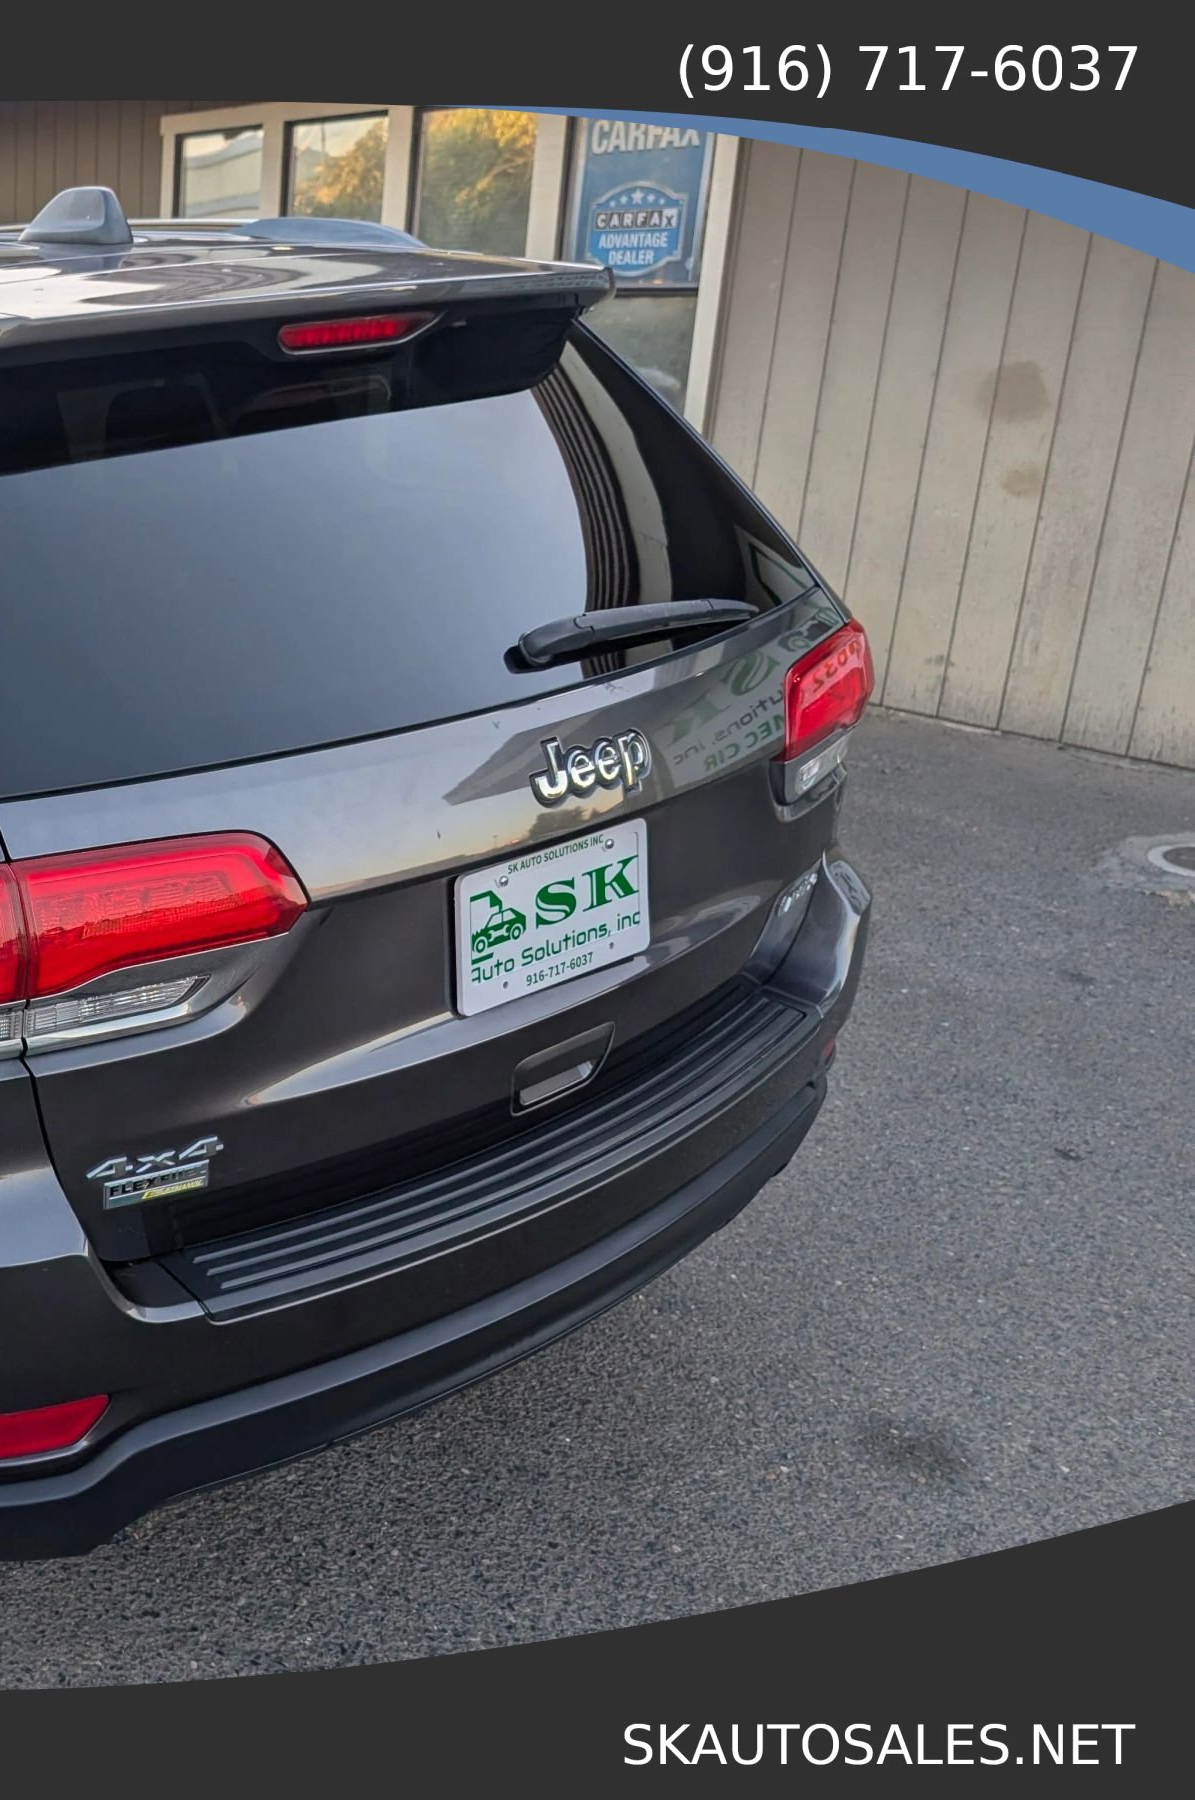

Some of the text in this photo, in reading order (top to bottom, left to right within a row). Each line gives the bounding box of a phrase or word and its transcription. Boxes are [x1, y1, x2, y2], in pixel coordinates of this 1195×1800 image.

[596, 209, 677, 229] CARFAX
[599, 232, 668, 249] ADVANTAGE
[608, 250, 654, 265] DEALER
[531, 731, 648, 804] Jeep
[507, 834, 604, 875] SK AUTO SOLUTIONS INC
[535, 855, 639, 929] SK
[521, 922, 612, 967] Solutions,
[617, 911, 641, 931] inc
[526, 951, 594, 987] 916-717-6037
